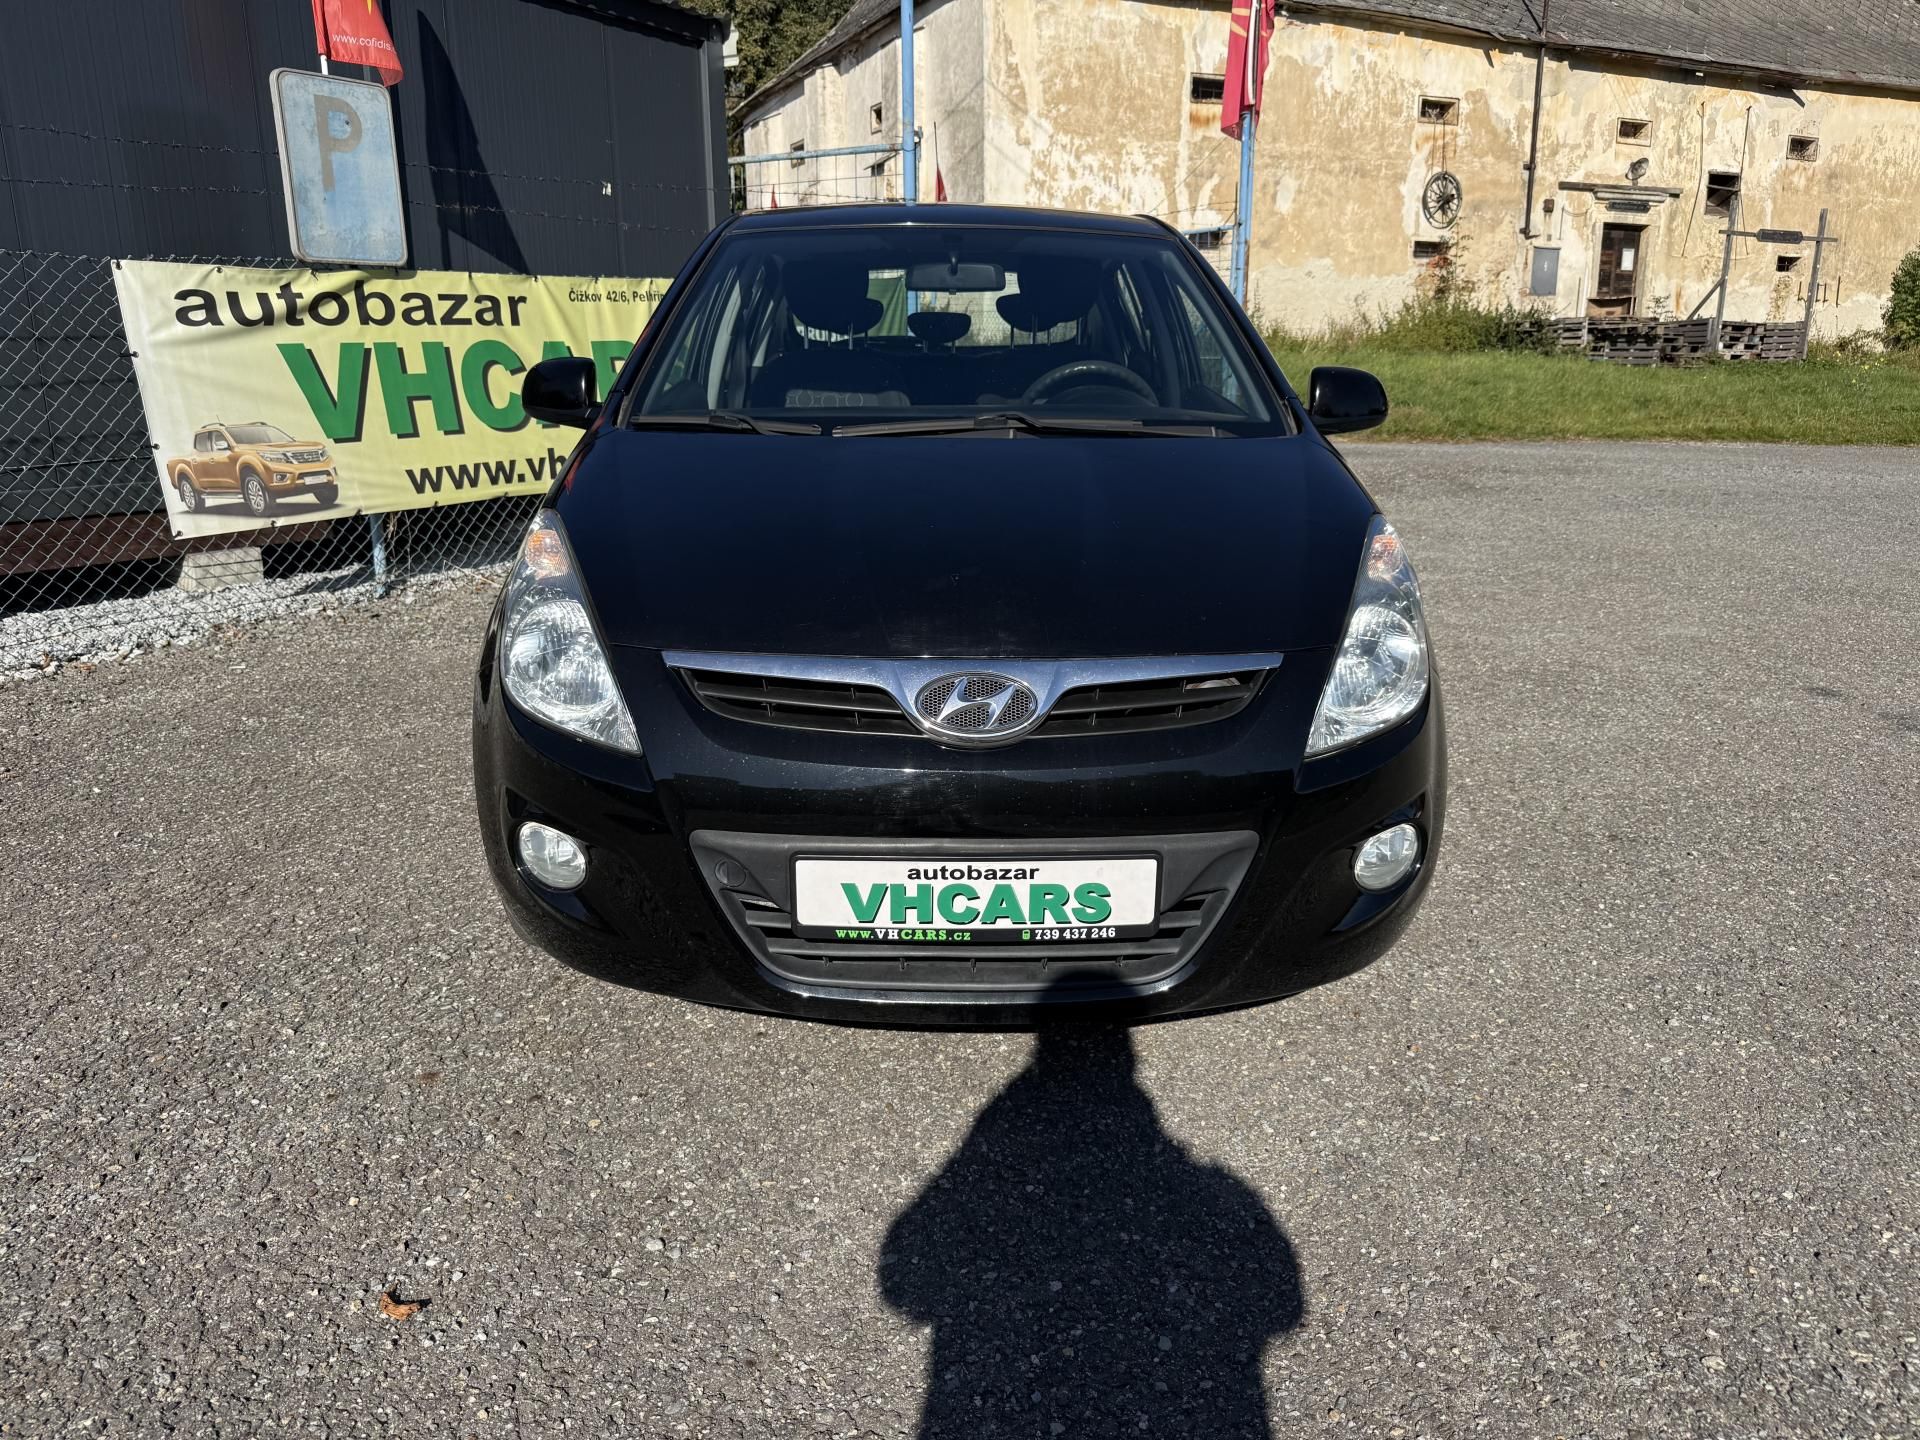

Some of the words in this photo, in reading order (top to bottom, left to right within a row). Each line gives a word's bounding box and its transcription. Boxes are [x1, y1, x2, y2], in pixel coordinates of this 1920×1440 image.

[313, 94, 363, 193] P
[174, 279, 527, 327] autobazar
[606, 291, 630, 304] 42/6,
[276, 338, 636, 443] VHC
[907, 865, 1040, 881] autobazar
[840, 882, 1112, 925] VHCARS
[835, 928, 971, 941] www.VHCARS.cz
[1035, 929, 1060, 940] 739
[1063, 928, 1087, 939] 437
[1091, 927, 1116, 938] 246
